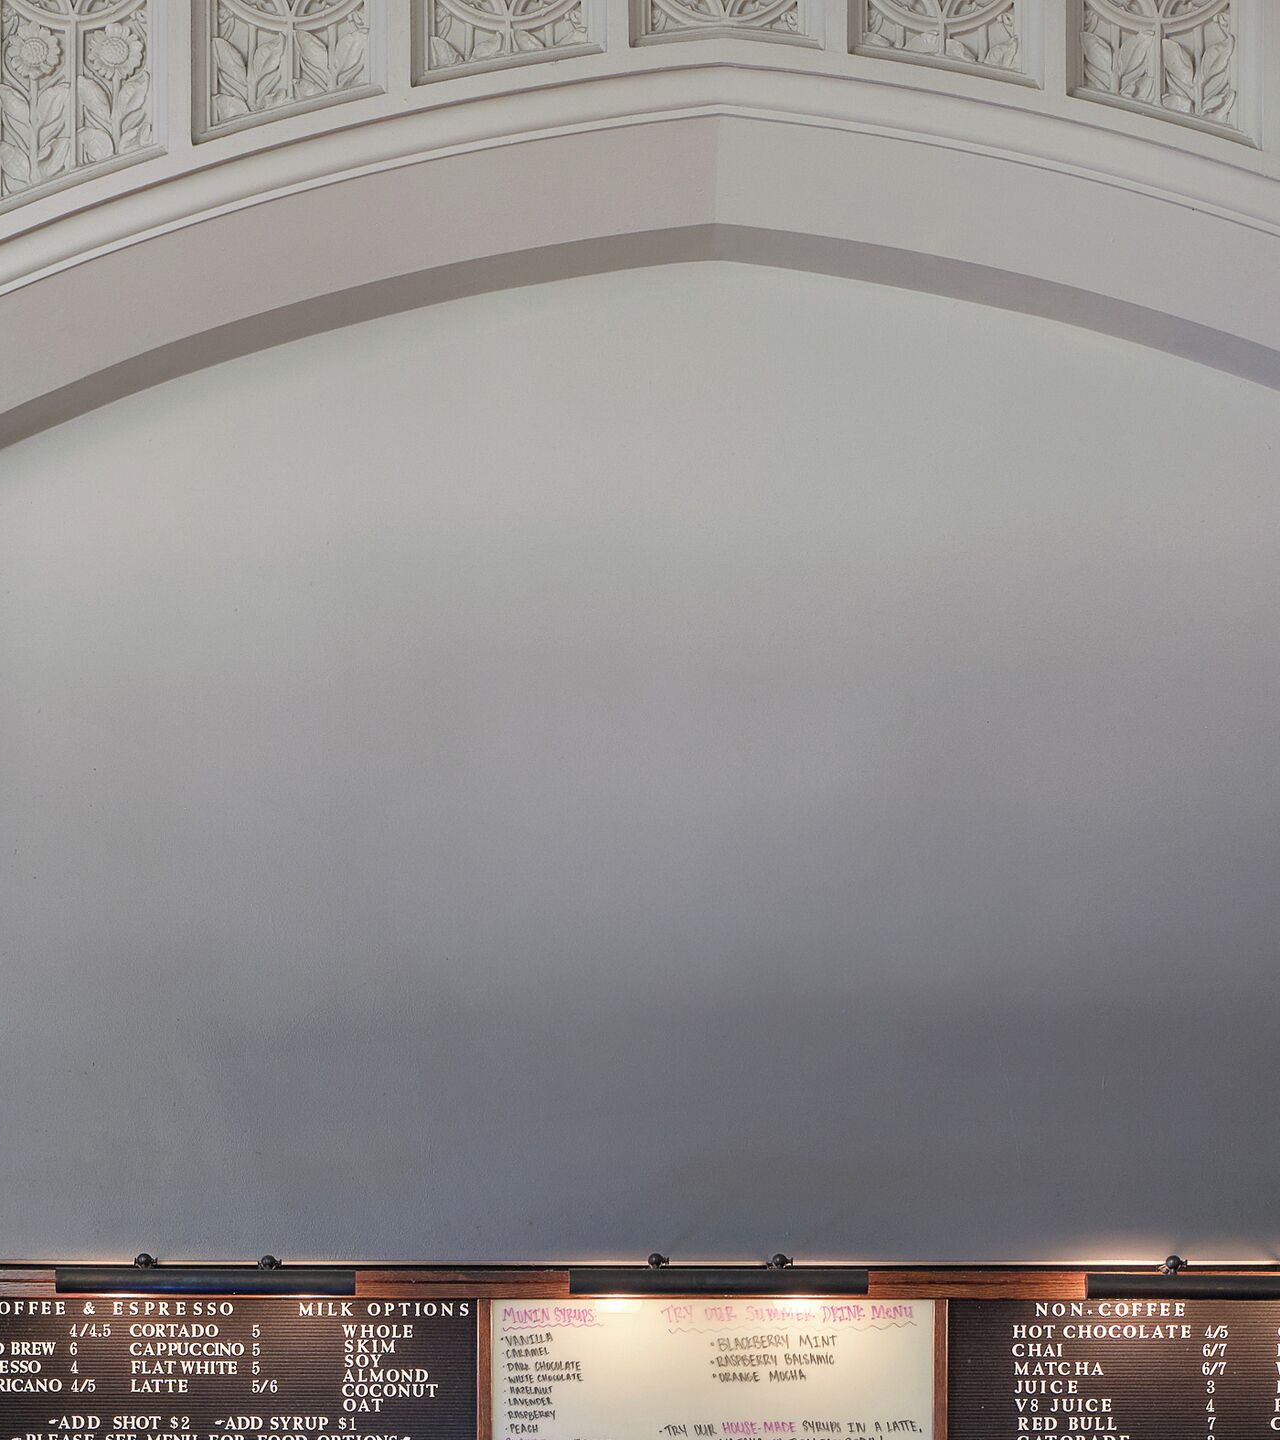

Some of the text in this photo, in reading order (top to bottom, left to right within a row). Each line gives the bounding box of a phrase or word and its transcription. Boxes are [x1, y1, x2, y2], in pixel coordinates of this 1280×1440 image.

[83, 1302, 96, 1315] &
[113, 1302, 234, 1315] ESPRESSO
[299, 1303, 469, 1316] MILK OPTIONS
[554, 1307, 595, 1323] SYRUPS
[661, 1306, 693, 1323] TRY
[704, 1306, 737, 1321] OUR
[822, 1305, 865, 1322] DRINK
[69, 1324, 111, 1337] 4/4.5
[129, 1324, 260, 1338] CORTADO 5
[342, 1324, 413, 1338] WHOLE
[1012, 1325, 1229, 1339] HOT CHOCOLATE 4/5
[505, 1332, 554, 1346] VANILLA
[717, 1334, 837, 1350] BLACKBERRY MINT
[11, 1342, 56, 1356] BREW
[70, 1342, 78, 1356] 6
[129, 1342, 261, 1356] CAPPUCCINO 5
[344, 1340, 395, 1353] SKIM
[505, 1347, 550, 1359] CARAMEL
[1011, 1343, 1228, 1357] CHAI 6/7
[70, 1361, 79, 1374] 4
[344, 1354, 382, 1368] SOY
[507, 1362, 530, 1372] DARK
[716, 1354, 778, 1367] RASPBERRY
[131, 1361, 261, 1375] FLAT WHITE 5
[1013, 1362, 1227, 1376] MATCHA 6/7
[342, 1369, 429, 1383] ALMOND
[718, 1369, 807, 1383] ORANGE MOCHA
[71, 1379, 96, 1393] 4/5
[131, 1380, 278, 1394] LATTE 5/6
[341, 1384, 439, 1398] COCONUT
[1015, 1380, 1216, 1394] JUICE 3
[343, 1399, 384, 1412] OAT
[508, 1397, 553, 1407] LAVENDER
[1015, 1398, 1215, 1412] V8 JUICE 4
[507, 1410, 556, 1420] RASPBERRY
[58, 1416, 190, 1430] ADD SHOT $2
[224, 1417, 357, 1431] ADD SYRUP $1
[510, 1424, 538, 1434] PEACH
[694, 1423, 718, 1435] OUR
[802, 1421, 842, 1433] SYRUPS
[848, 1421, 867, 1433] IN
[874, 1422, 882, 1432] A
[1017, 1417, 1217, 1431] RED BULL 7
